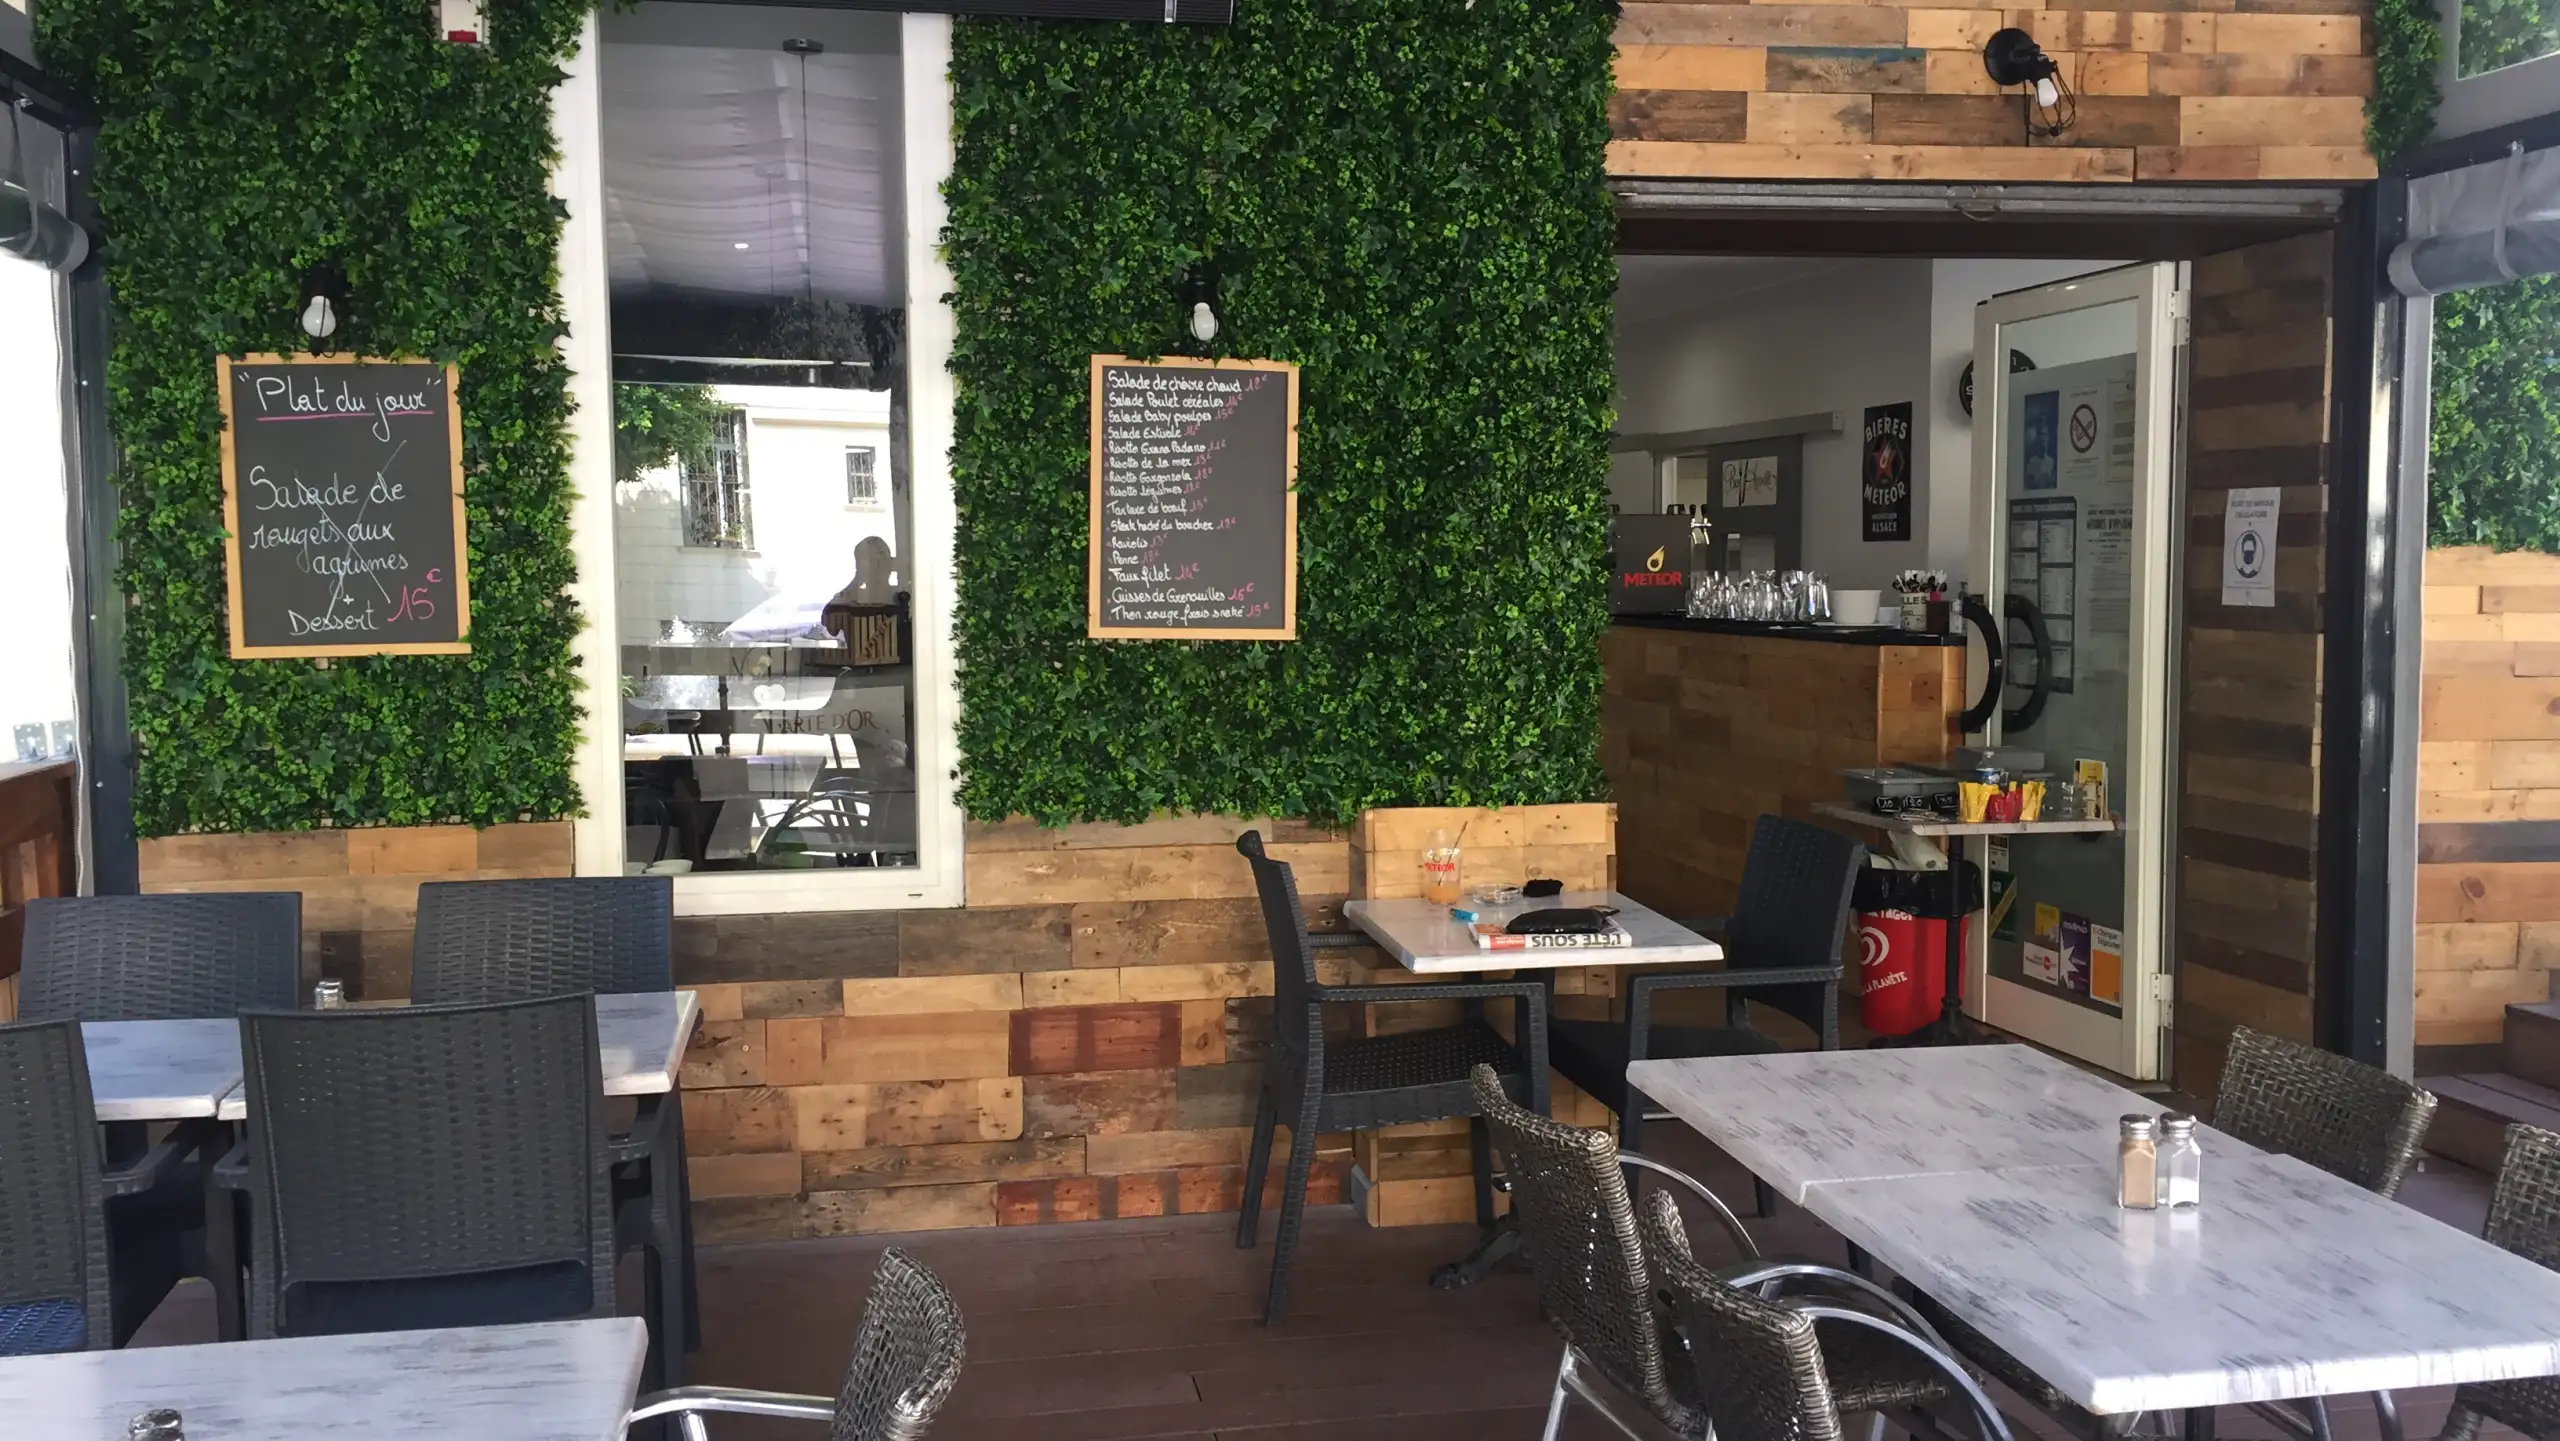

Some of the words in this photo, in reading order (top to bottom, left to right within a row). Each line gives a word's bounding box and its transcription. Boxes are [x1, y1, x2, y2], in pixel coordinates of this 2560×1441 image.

[1108, 370, 1150, 389] Salade
[1152, 373, 1168, 390] de
[1206, 376, 1241, 393] chaud
[336, 381, 366, 413] du
[1109, 391, 1144, 408] Salade
[1146, 391, 1179, 408] Poulet
[1108, 410, 1143, 423] Salade
[1144, 410, 1171, 427] Baby
[1173, 410, 1212, 428] poulpes
[1107, 426, 1141, 440] Salade
[1143, 425, 1182, 440] Estivale
[1108, 440, 1138, 454] Risotto
[1140, 441, 1170, 454] Grana
[1171, 440, 1206, 453] Padano
[1109, 456, 1139, 469] Risotto
[1141, 457, 1153, 469] de
[1172, 458, 1192, 468] mer
[1108, 470, 1138, 483] Risotto
[1139, 469, 1193, 486] Gorgonzola
[249, 465, 357, 511] Salade
[370, 471, 406, 504] de
[1109, 485, 1138, 497] Risotto
[1106, 500, 1146, 516] Tartare
[1147, 503, 1159, 514] de
[1110, 518, 1136, 532] Steak
[1161, 519, 1173, 531] du
[1174, 518, 1214, 531] boucher
[249, 513, 341, 573] rougets
[347, 521, 396, 542] aux
[1112, 550, 1139, 565] Penne
[312, 552, 409, 600] agrumes
[1108, 567, 1140, 583] Faux
[1141, 563, 1172, 588] filet
[1624, 571, 1682, 588] METEOR
[1111, 586, 1151, 604] Cuisses
[1151, 588, 1165, 603] de
[1166, 585, 1226, 604] Grenouilles
[288, 600, 379, 636] Dessert
[1111, 605, 1142, 621] Thon
[1143, 607, 1179, 626] rouge
[1179, 604, 1210, 626] frais
[832, 709, 881, 732] D'OR
[1531, 934, 1578, 948] SOUS
